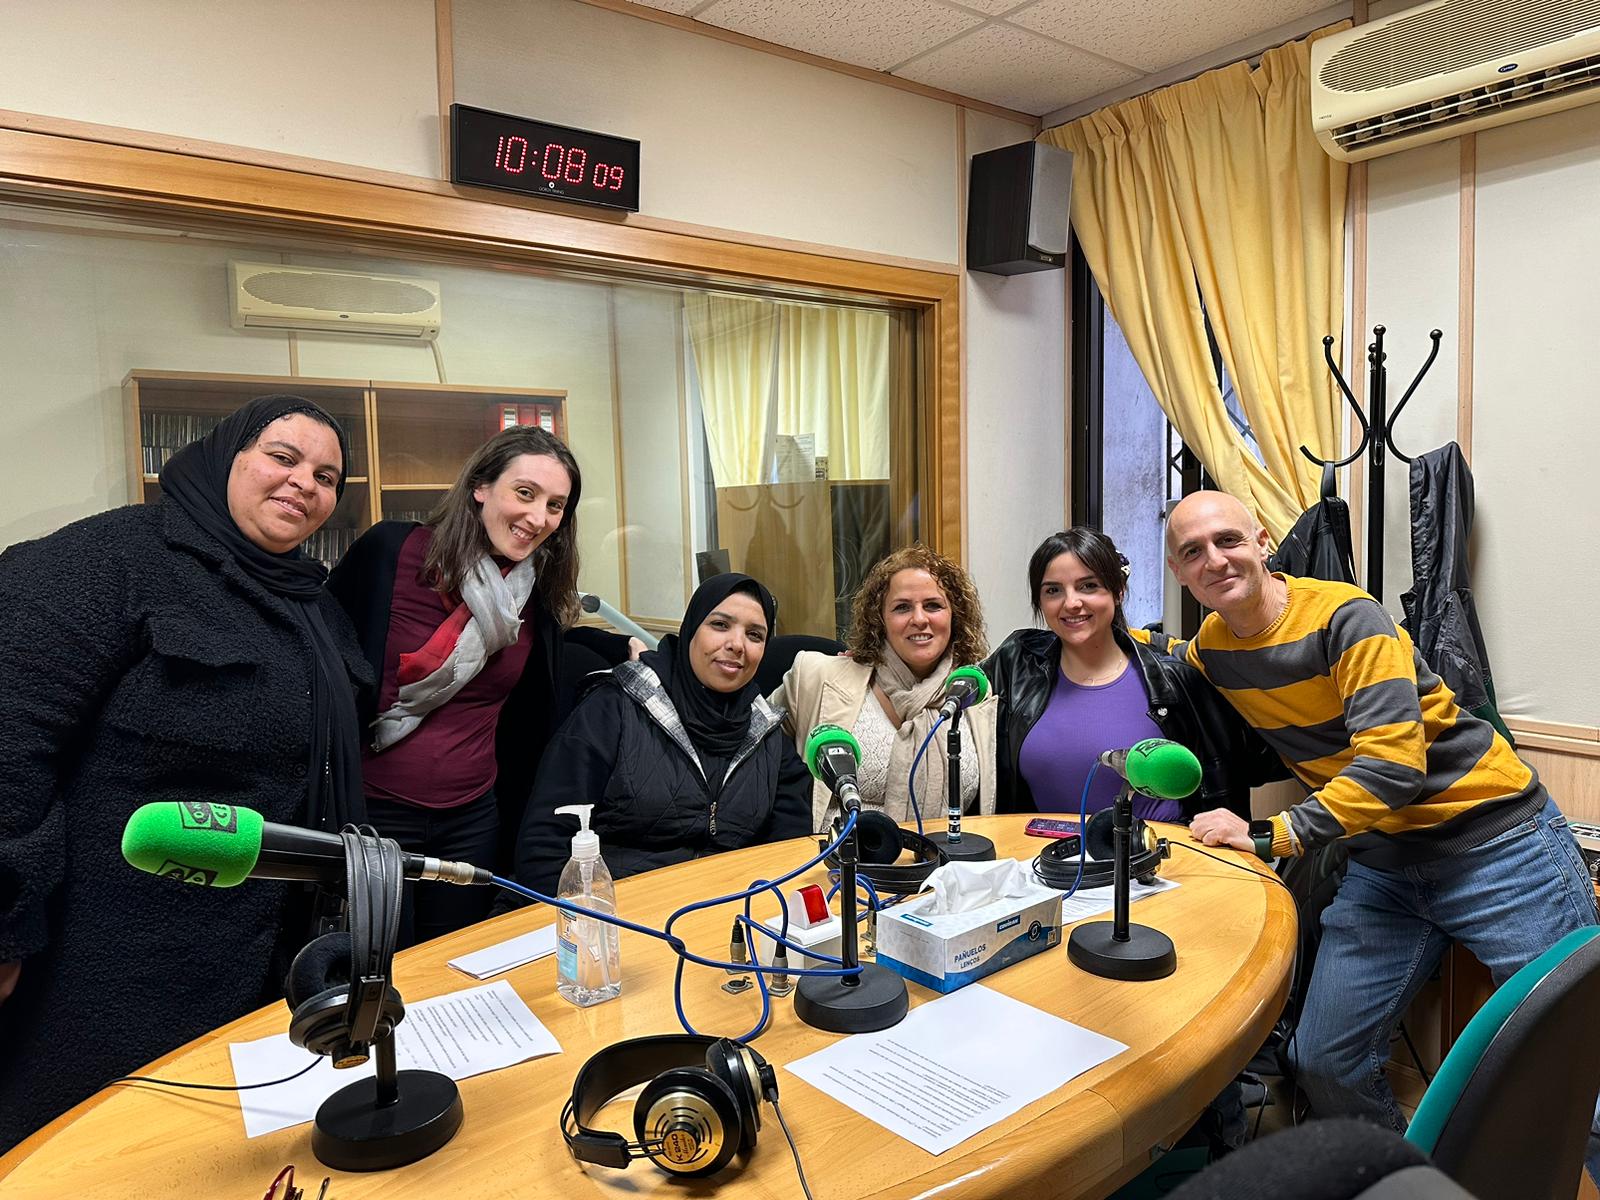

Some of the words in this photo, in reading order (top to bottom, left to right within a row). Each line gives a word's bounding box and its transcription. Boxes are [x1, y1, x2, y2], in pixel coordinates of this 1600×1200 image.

[495, 136, 587, 183] 10:08
[592, 163, 625, 190] 09
[954, 943, 986, 963] PAÑUELOS
[960, 956, 980, 969] LENÇOS
